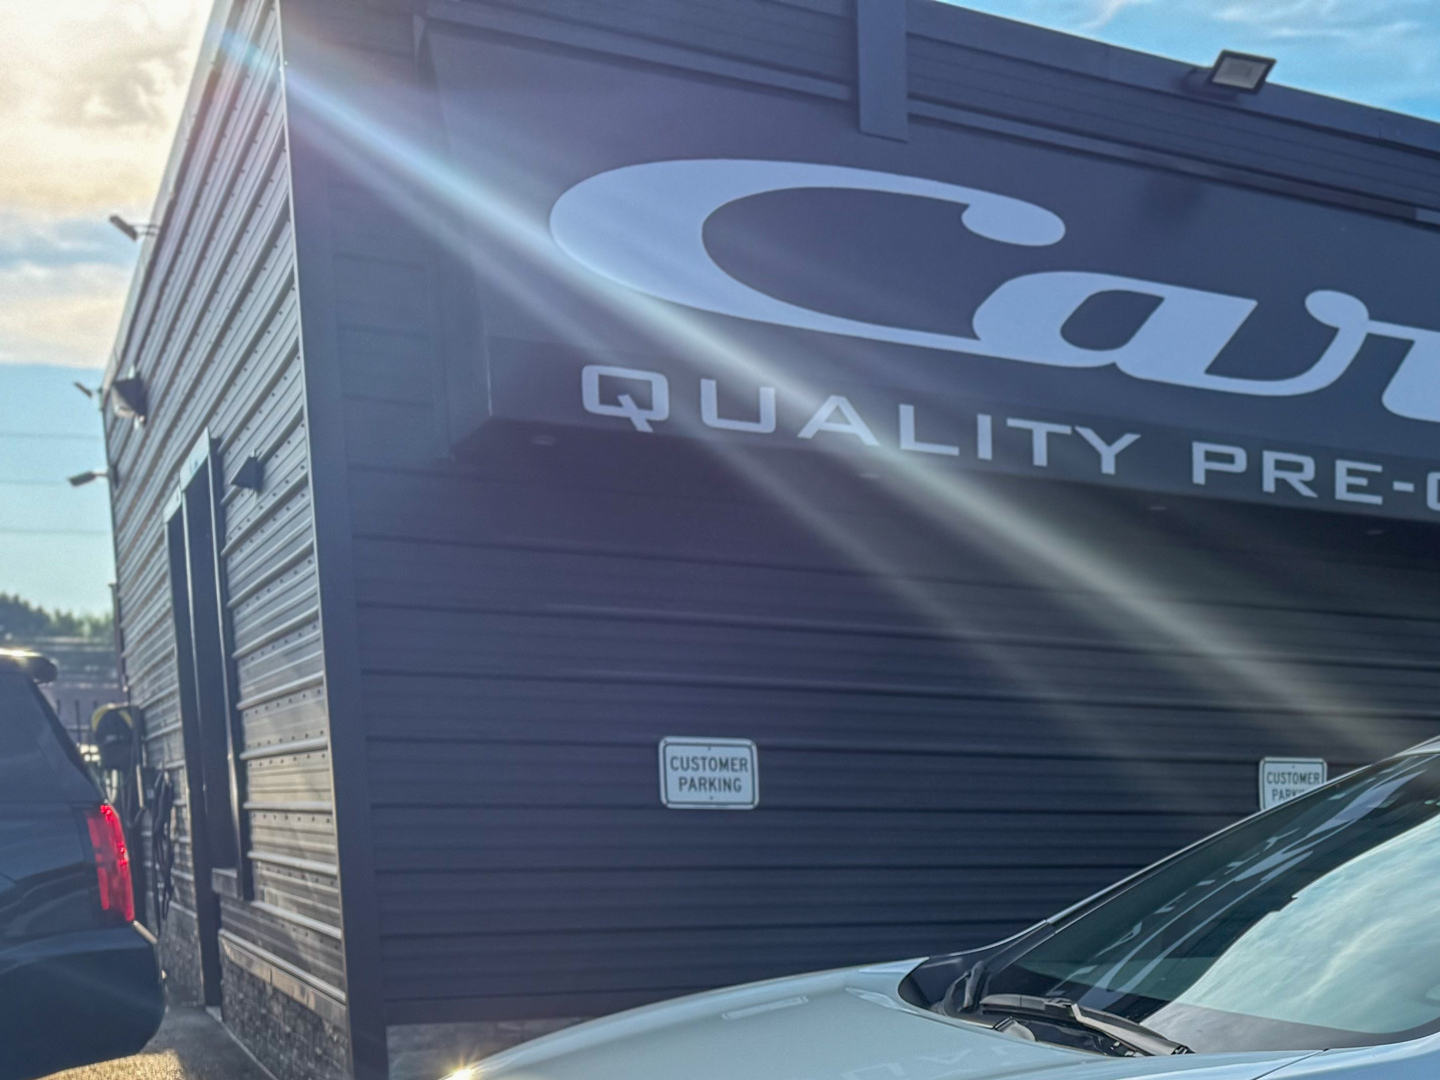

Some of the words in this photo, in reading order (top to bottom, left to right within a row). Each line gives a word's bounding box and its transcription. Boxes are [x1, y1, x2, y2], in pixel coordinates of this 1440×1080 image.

[581, 364, 1142, 475] QUALITY
[669, 755, 749, 772] CUSTOMER
[678, 776, 742, 792] PARKING
[1266, 771, 1321, 785] CUSTOMER
[1271, 788, 1306, 803] PARK
